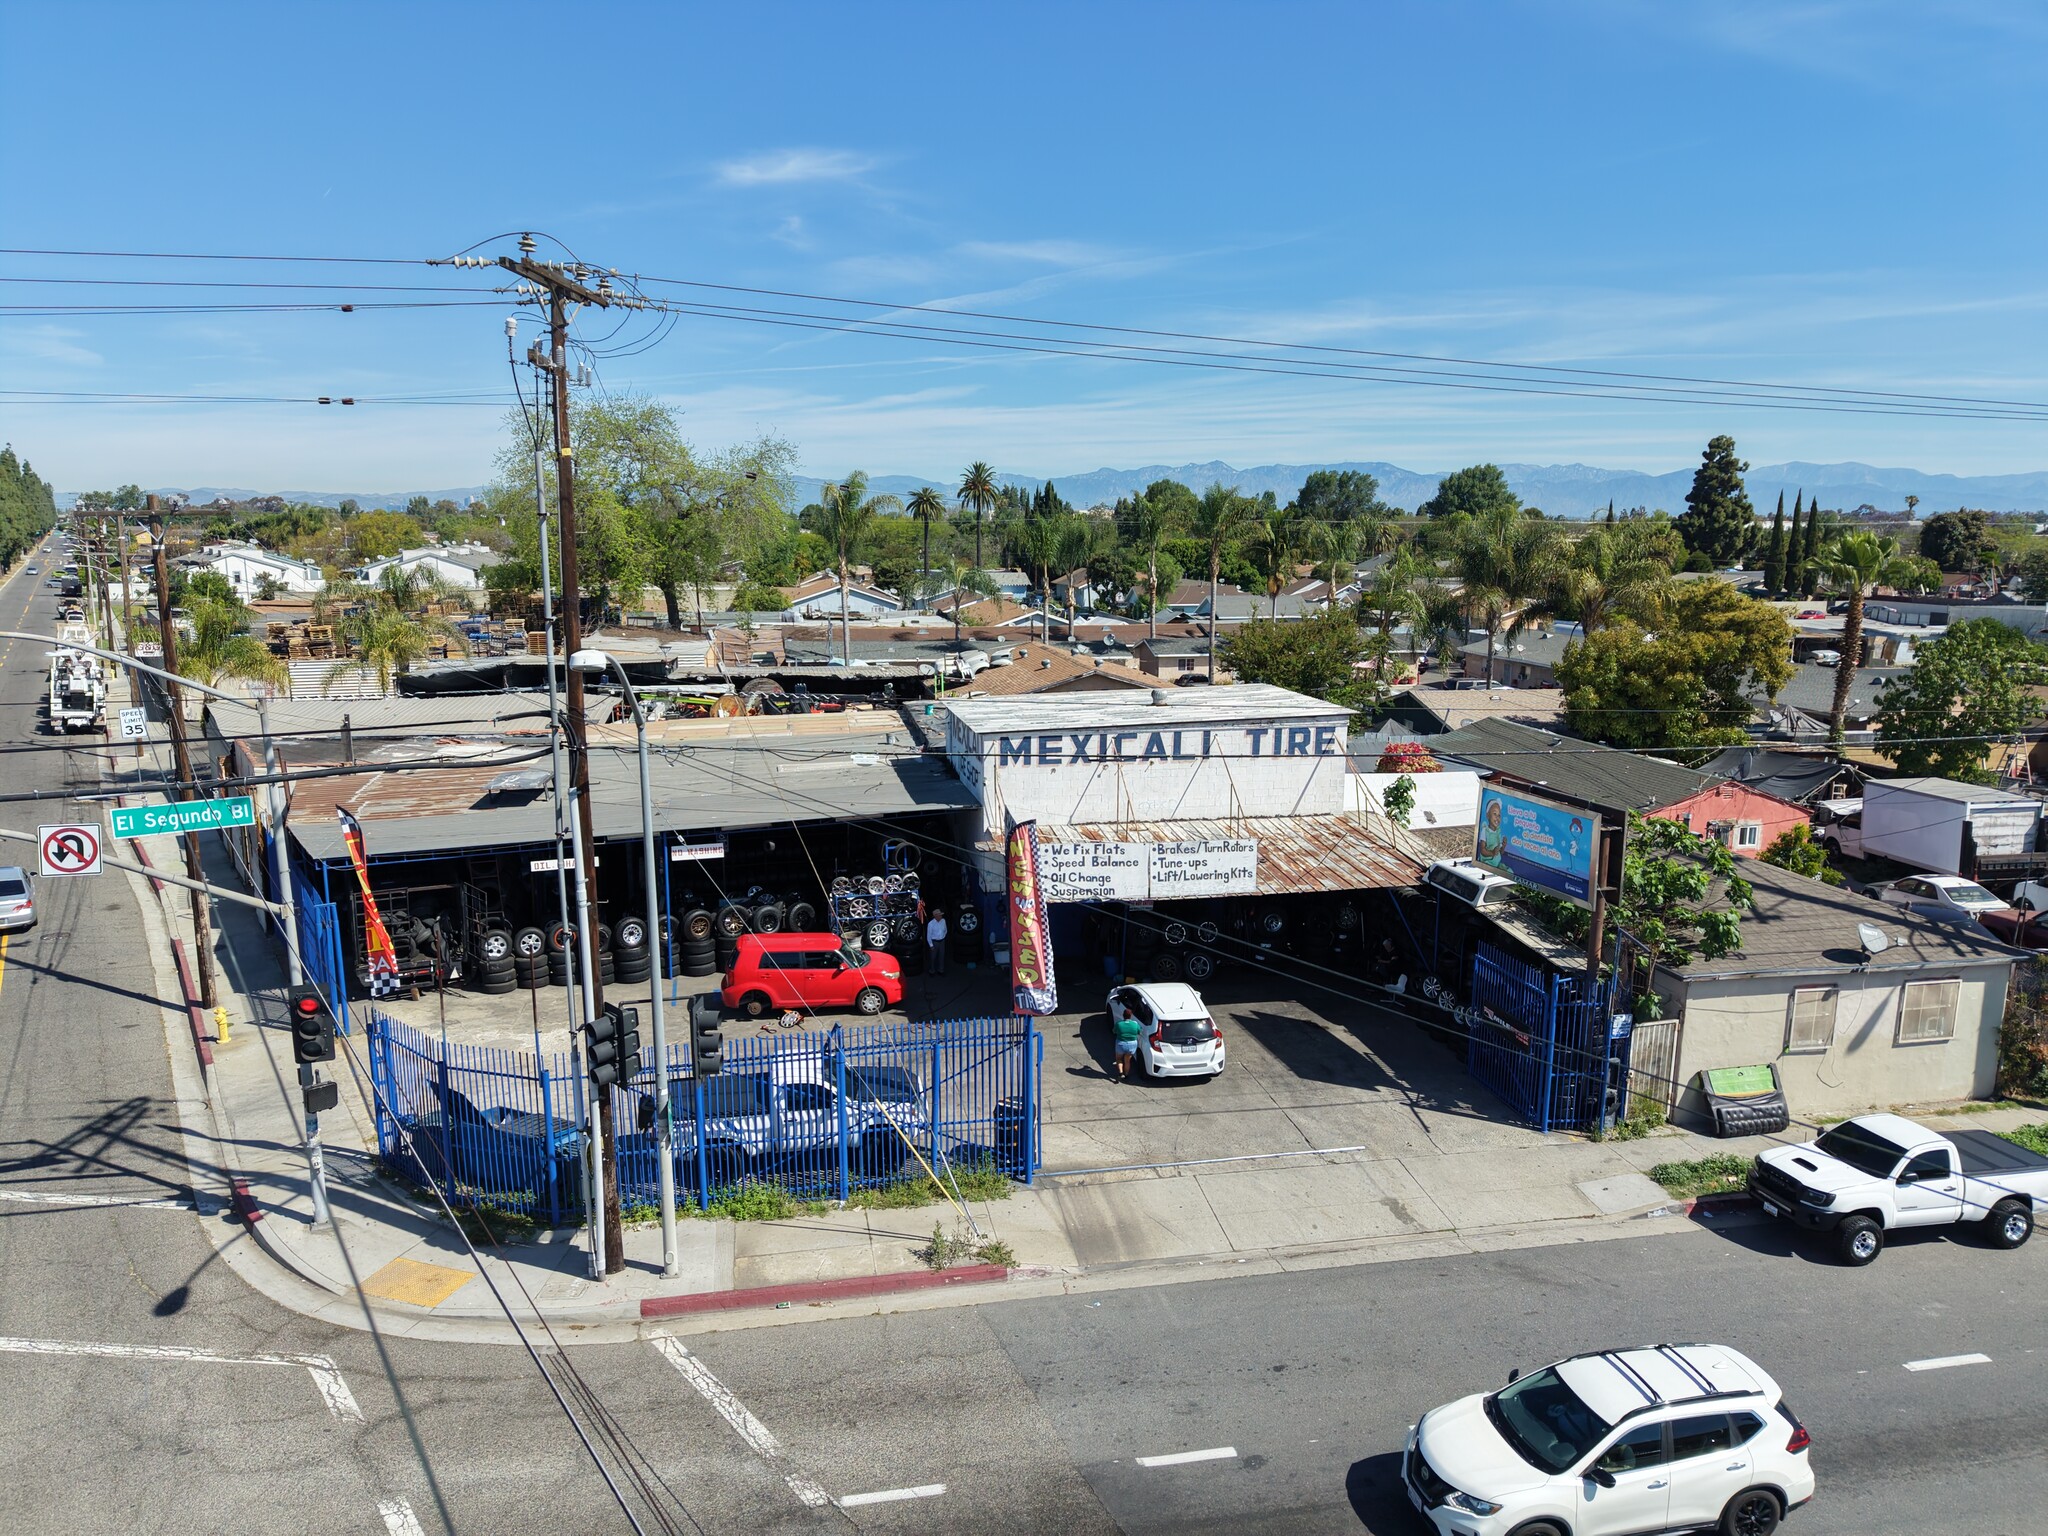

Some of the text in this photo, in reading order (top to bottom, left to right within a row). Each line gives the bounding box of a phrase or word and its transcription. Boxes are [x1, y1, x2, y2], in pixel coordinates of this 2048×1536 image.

[125, 725, 144, 735] 35
[1000, 726, 1336, 766] MEXICALI TIRE
[116, 803, 249, 831] El Segundo Bl
[672, 846, 723, 857] NO WASHING
[1051, 844, 1126, 855] We Fix Flats
[1051, 856, 1139, 871] Speed Balance
[1158, 857, 1208, 870] Tune-ups
[1051, 872, 1112, 887] Oil Change
[1230, 867, 1253, 878] Kits
[1514, 876, 1537, 889] LAMAR
[1050, 884, 1116, 899] Suspension
[1015, 987, 1054, 1010] TIRES
